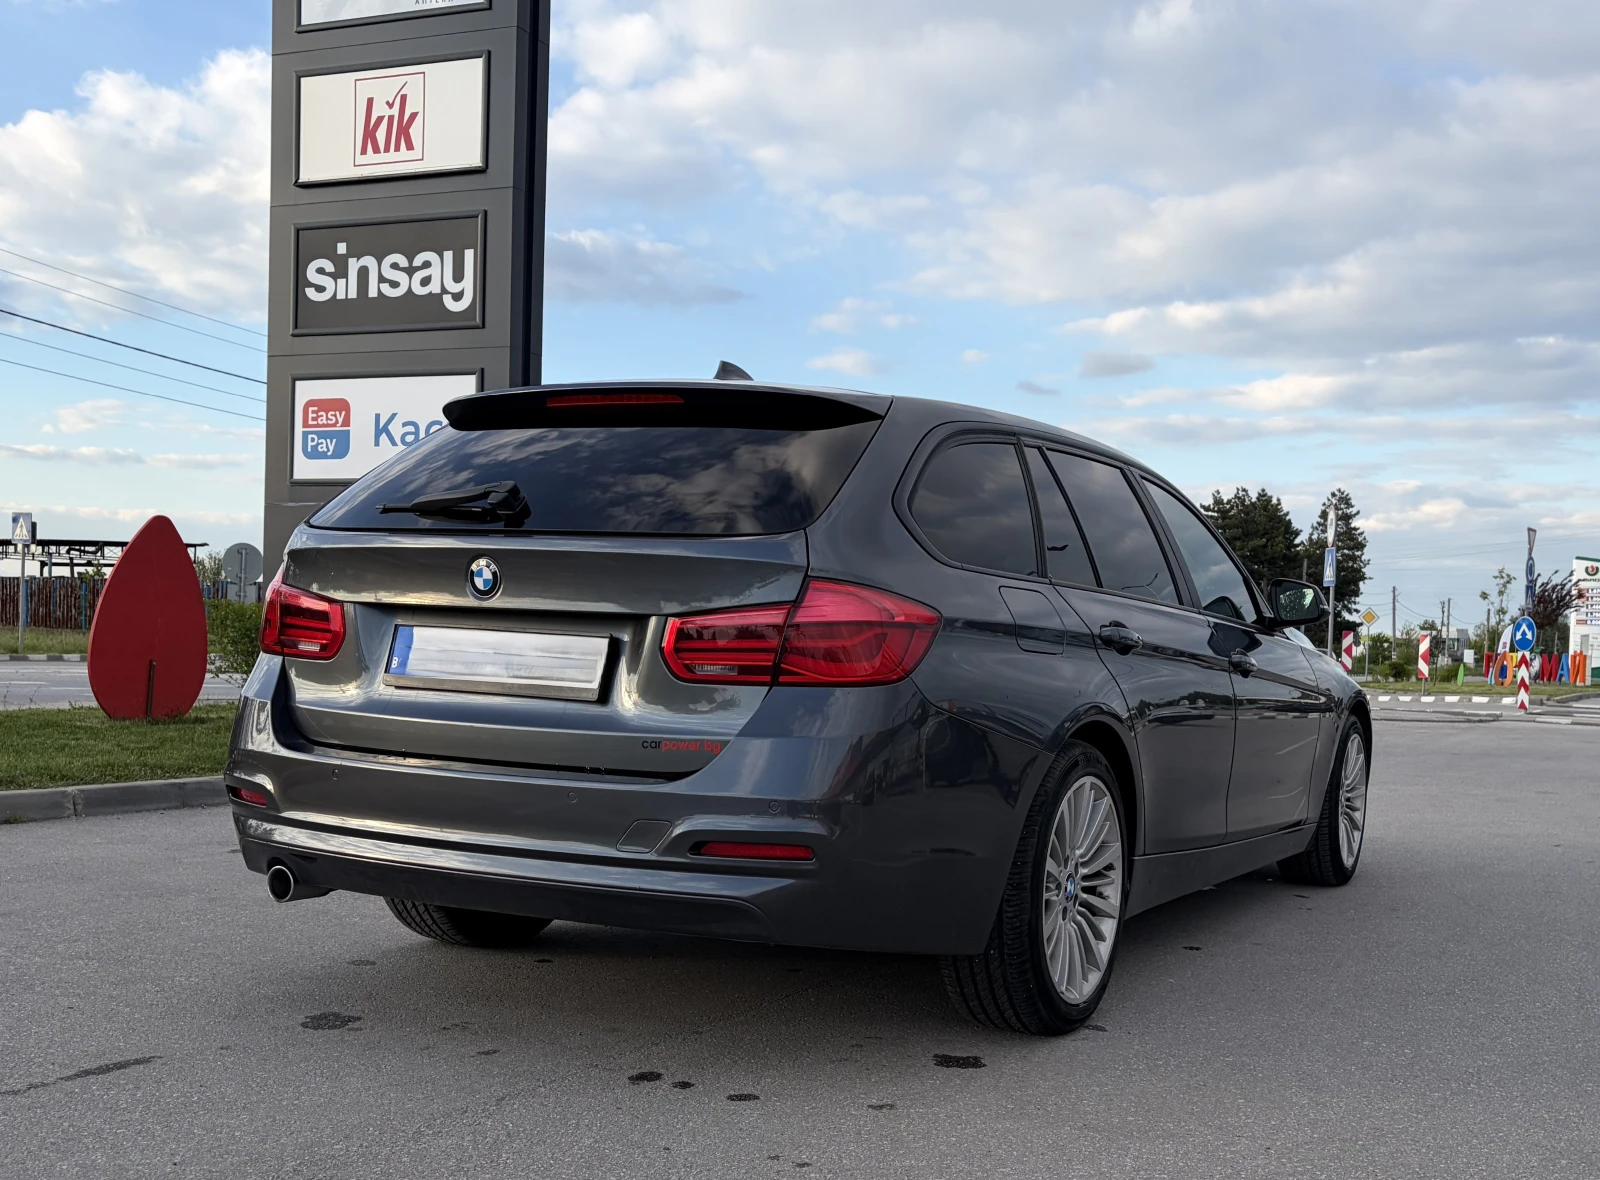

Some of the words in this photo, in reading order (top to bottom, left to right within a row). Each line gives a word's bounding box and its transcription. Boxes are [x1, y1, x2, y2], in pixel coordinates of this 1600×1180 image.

[304, 242, 475, 312] sinsay
[307, 406, 346, 427] Easy
[307, 434, 336, 456] Pay
[641, 739, 723, 755] carpower.bg
